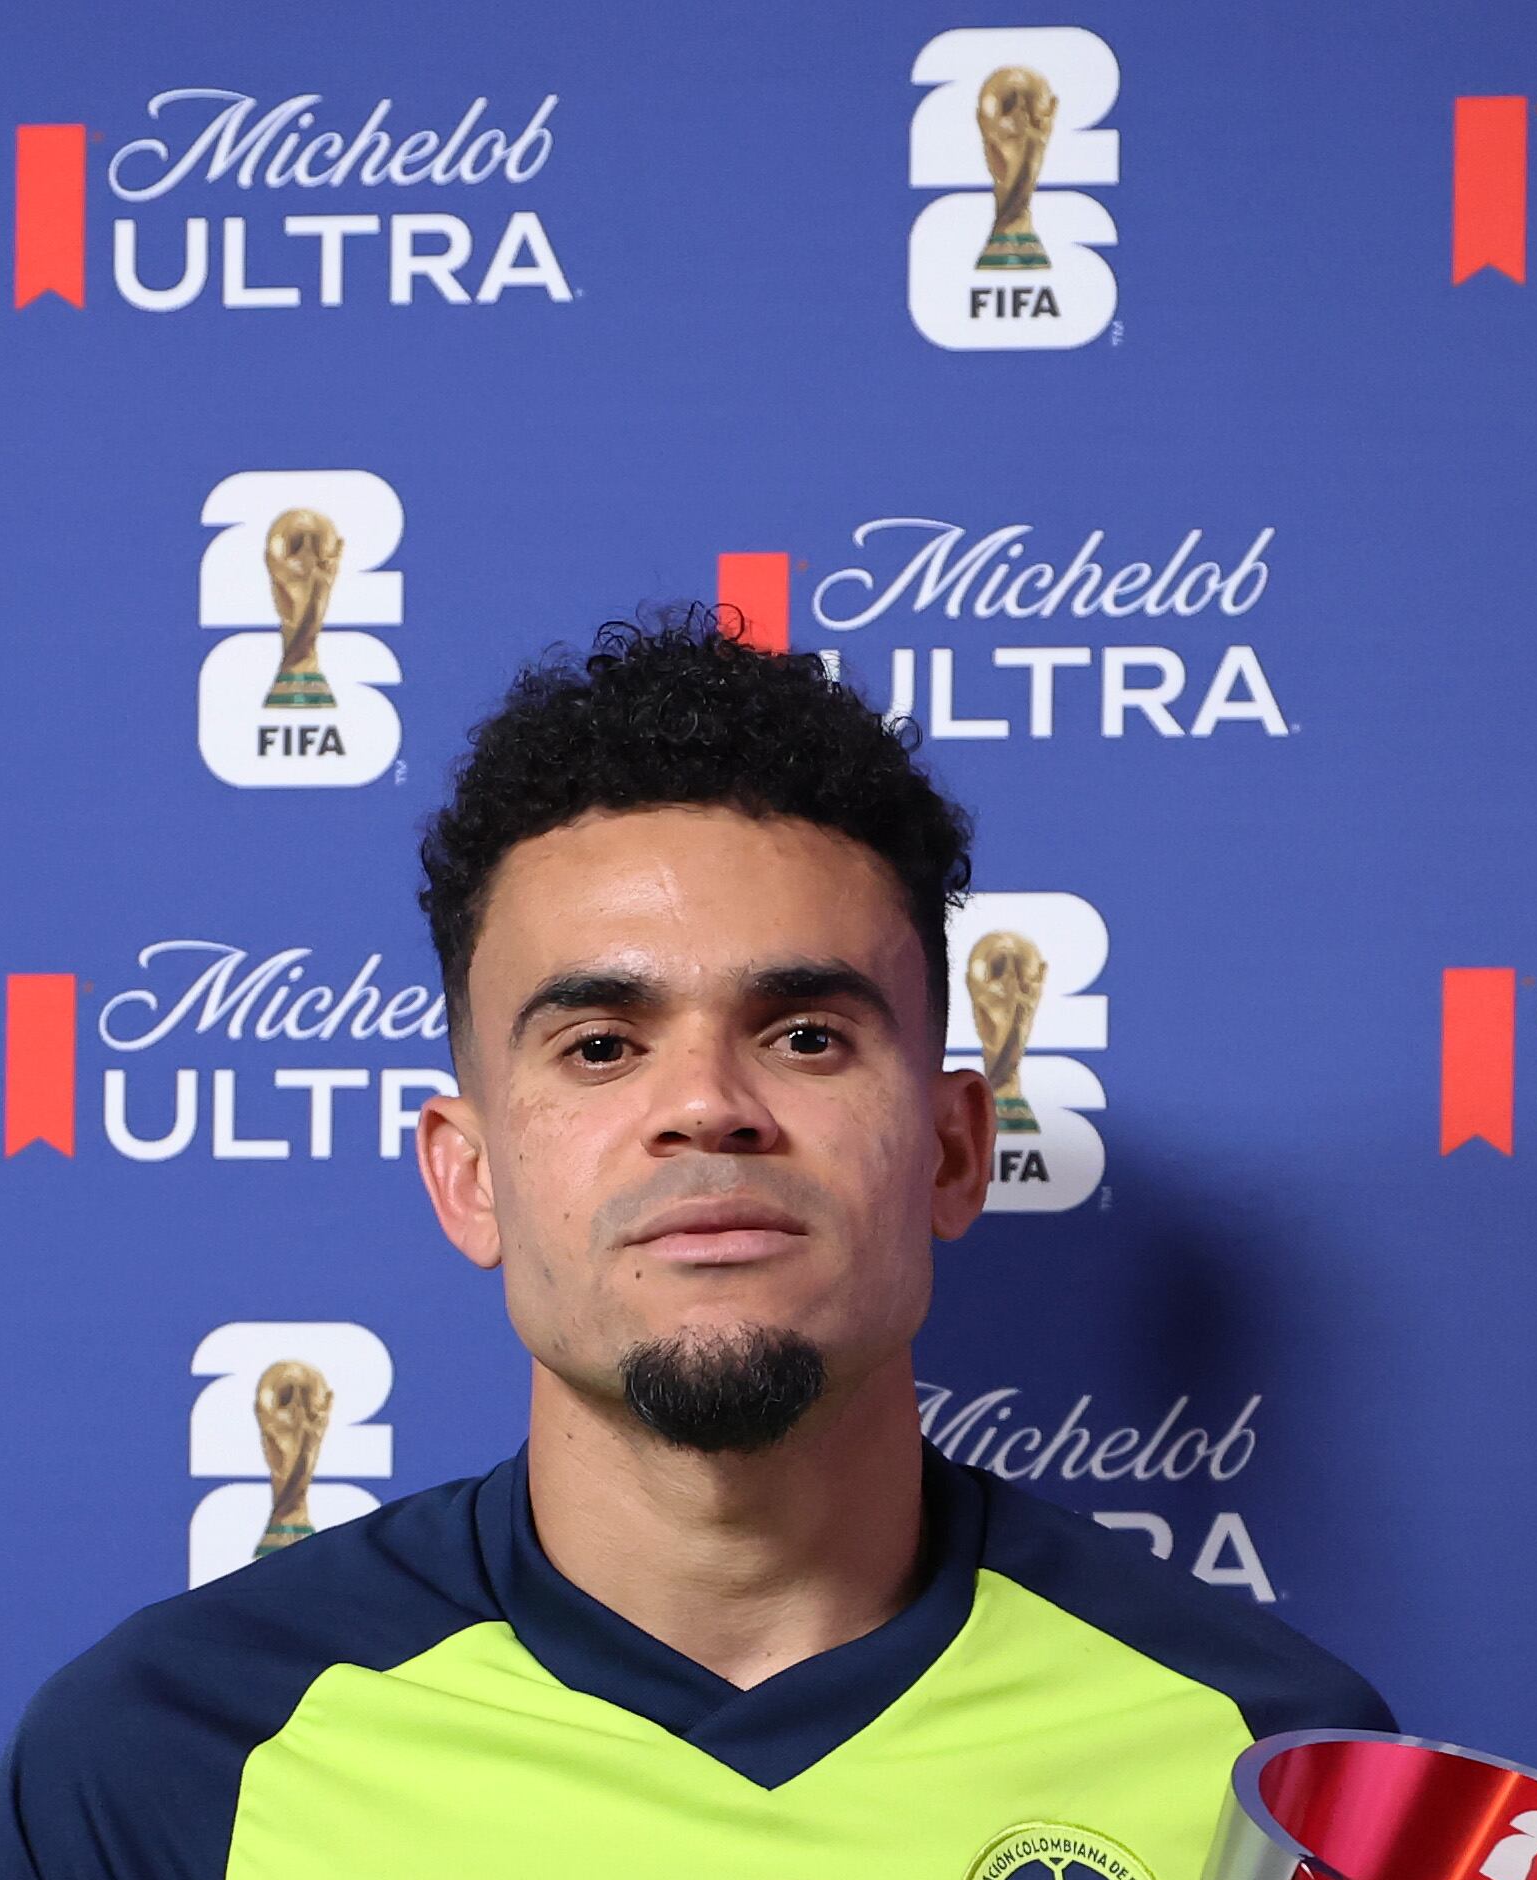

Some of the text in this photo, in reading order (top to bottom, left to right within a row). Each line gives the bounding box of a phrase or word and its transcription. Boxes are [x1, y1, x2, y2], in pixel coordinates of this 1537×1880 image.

[109, 89, 557, 201] Michelob
[114, 212, 573, 312] ULTRA
[970, 287, 1059, 319] FIFA
[813, 518, 1275, 631] Michelob
[258, 726, 345, 756] FIFA
[104, 1068, 460, 1161] ULTR
[1014, 1836, 1108, 1868] COLOMBIANA
[1108, 1859, 1129, 1880] DE
